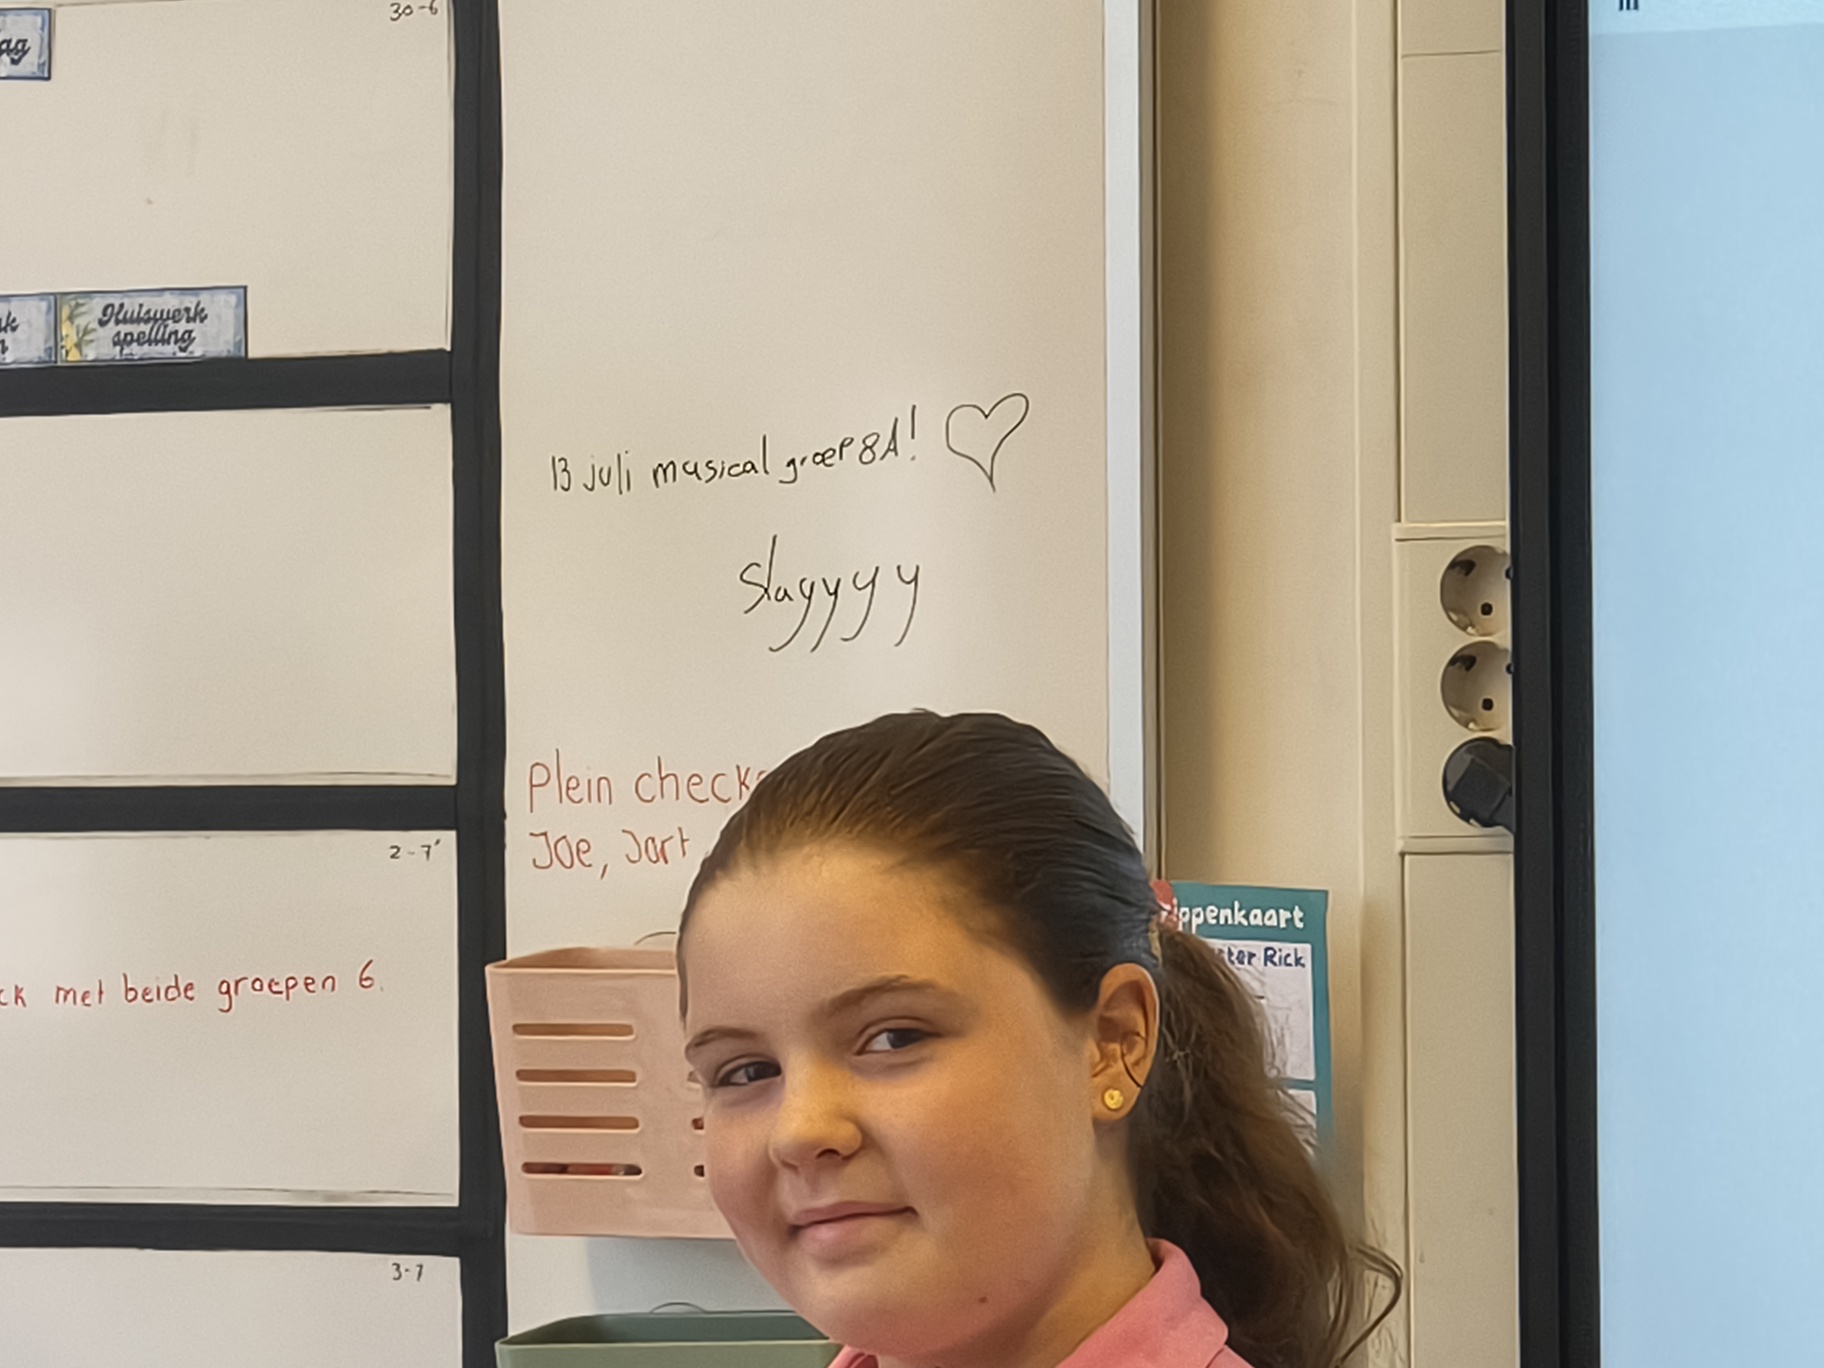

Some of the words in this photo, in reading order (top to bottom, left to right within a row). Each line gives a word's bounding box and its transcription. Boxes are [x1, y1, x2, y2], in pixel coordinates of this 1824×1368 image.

[97, 301, 209, 329] Huiswerk
[112, 326, 196, 355] spelling
[551, 455, 572, 491] 13
[582, 450, 632, 494] juli
[652, 434, 770, 489] musical
[528, 748, 613, 813] Plein
[530, 829, 610, 879] Joe,
[1263, 946, 1306, 968] Rick
[54, 978, 104, 1007] met
[122, 972, 195, 1005] beide
[218, 971, 338, 1014] groepen
